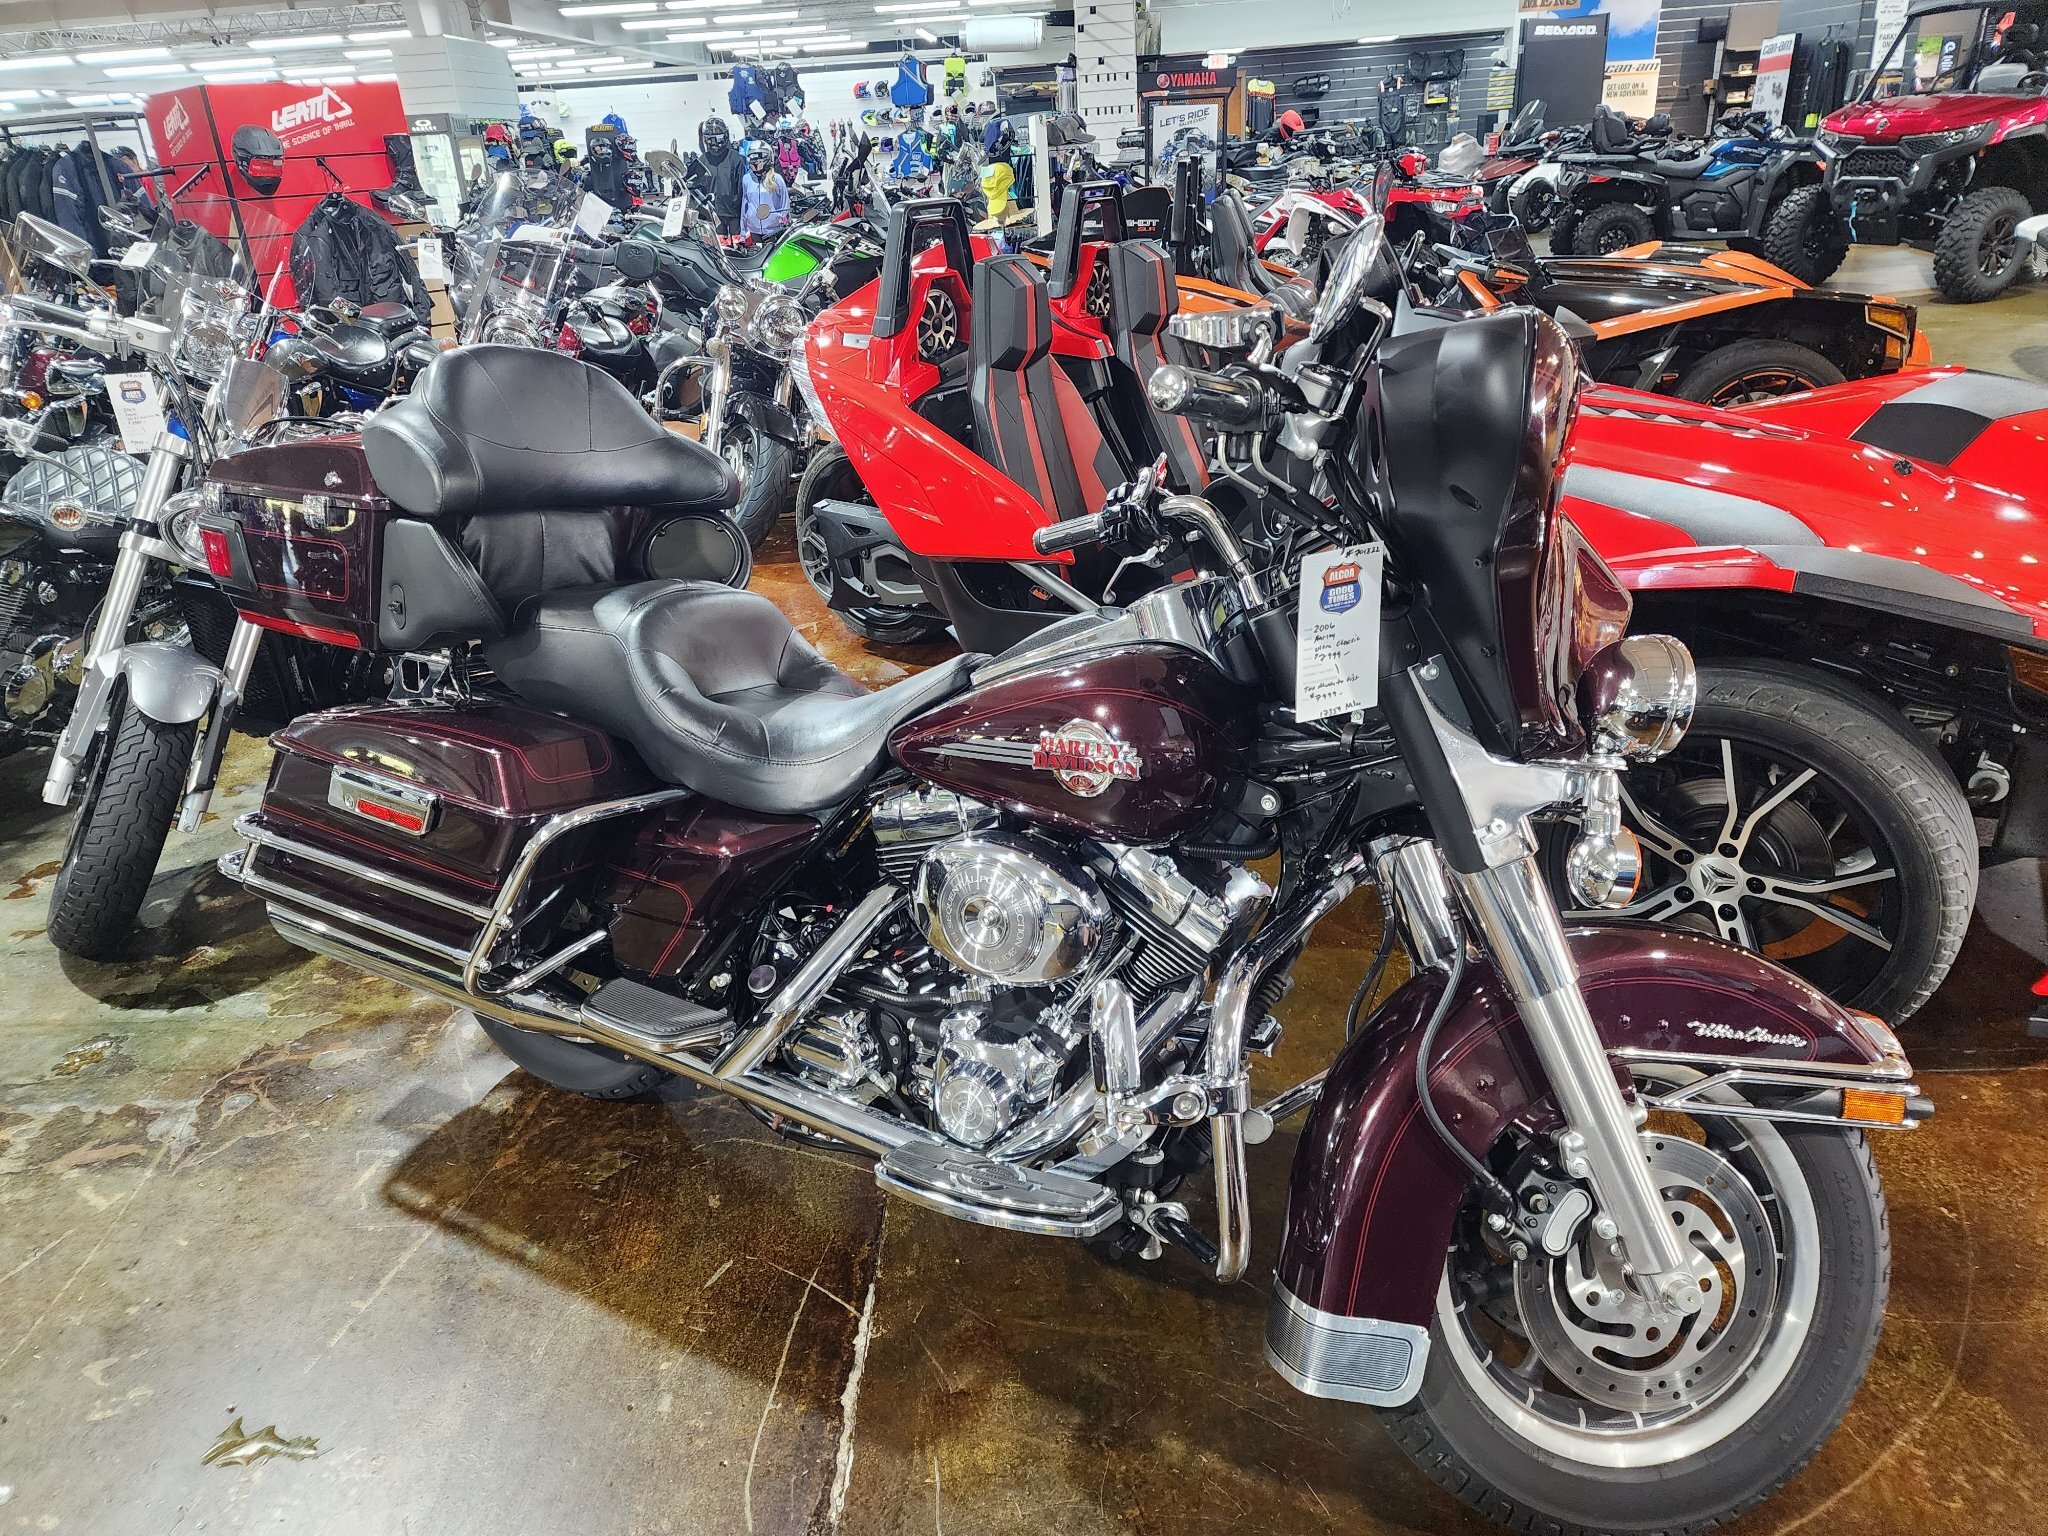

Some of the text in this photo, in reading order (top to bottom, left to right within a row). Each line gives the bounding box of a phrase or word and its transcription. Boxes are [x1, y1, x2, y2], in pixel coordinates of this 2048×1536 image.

[1170, 71, 1217, 87] YAMAHA
[1606, 83, 1616, 91] GET
[1618, 82, 1630, 91] LOST
[1631, 82, 1639, 90] ON
[1619, 90, 1648, 98] ADVENTURE
[1160, 107, 1210, 128] LET'S RIDE
[292, 130, 322, 147] SCIENCE
[322, 126, 333, 138] OF
[334, 119, 356, 135] THRILL
[1329, 567, 1355, 582] ALCOA
[1327, 591, 1355, 605] TIMES
[1329, 585, 1354, 597] GOOD
[1313, 622, 1336, 634] 2006
[1040, 736, 1122, 760] HARLEY
[1033, 751, 1140, 780] DAVIDSON
